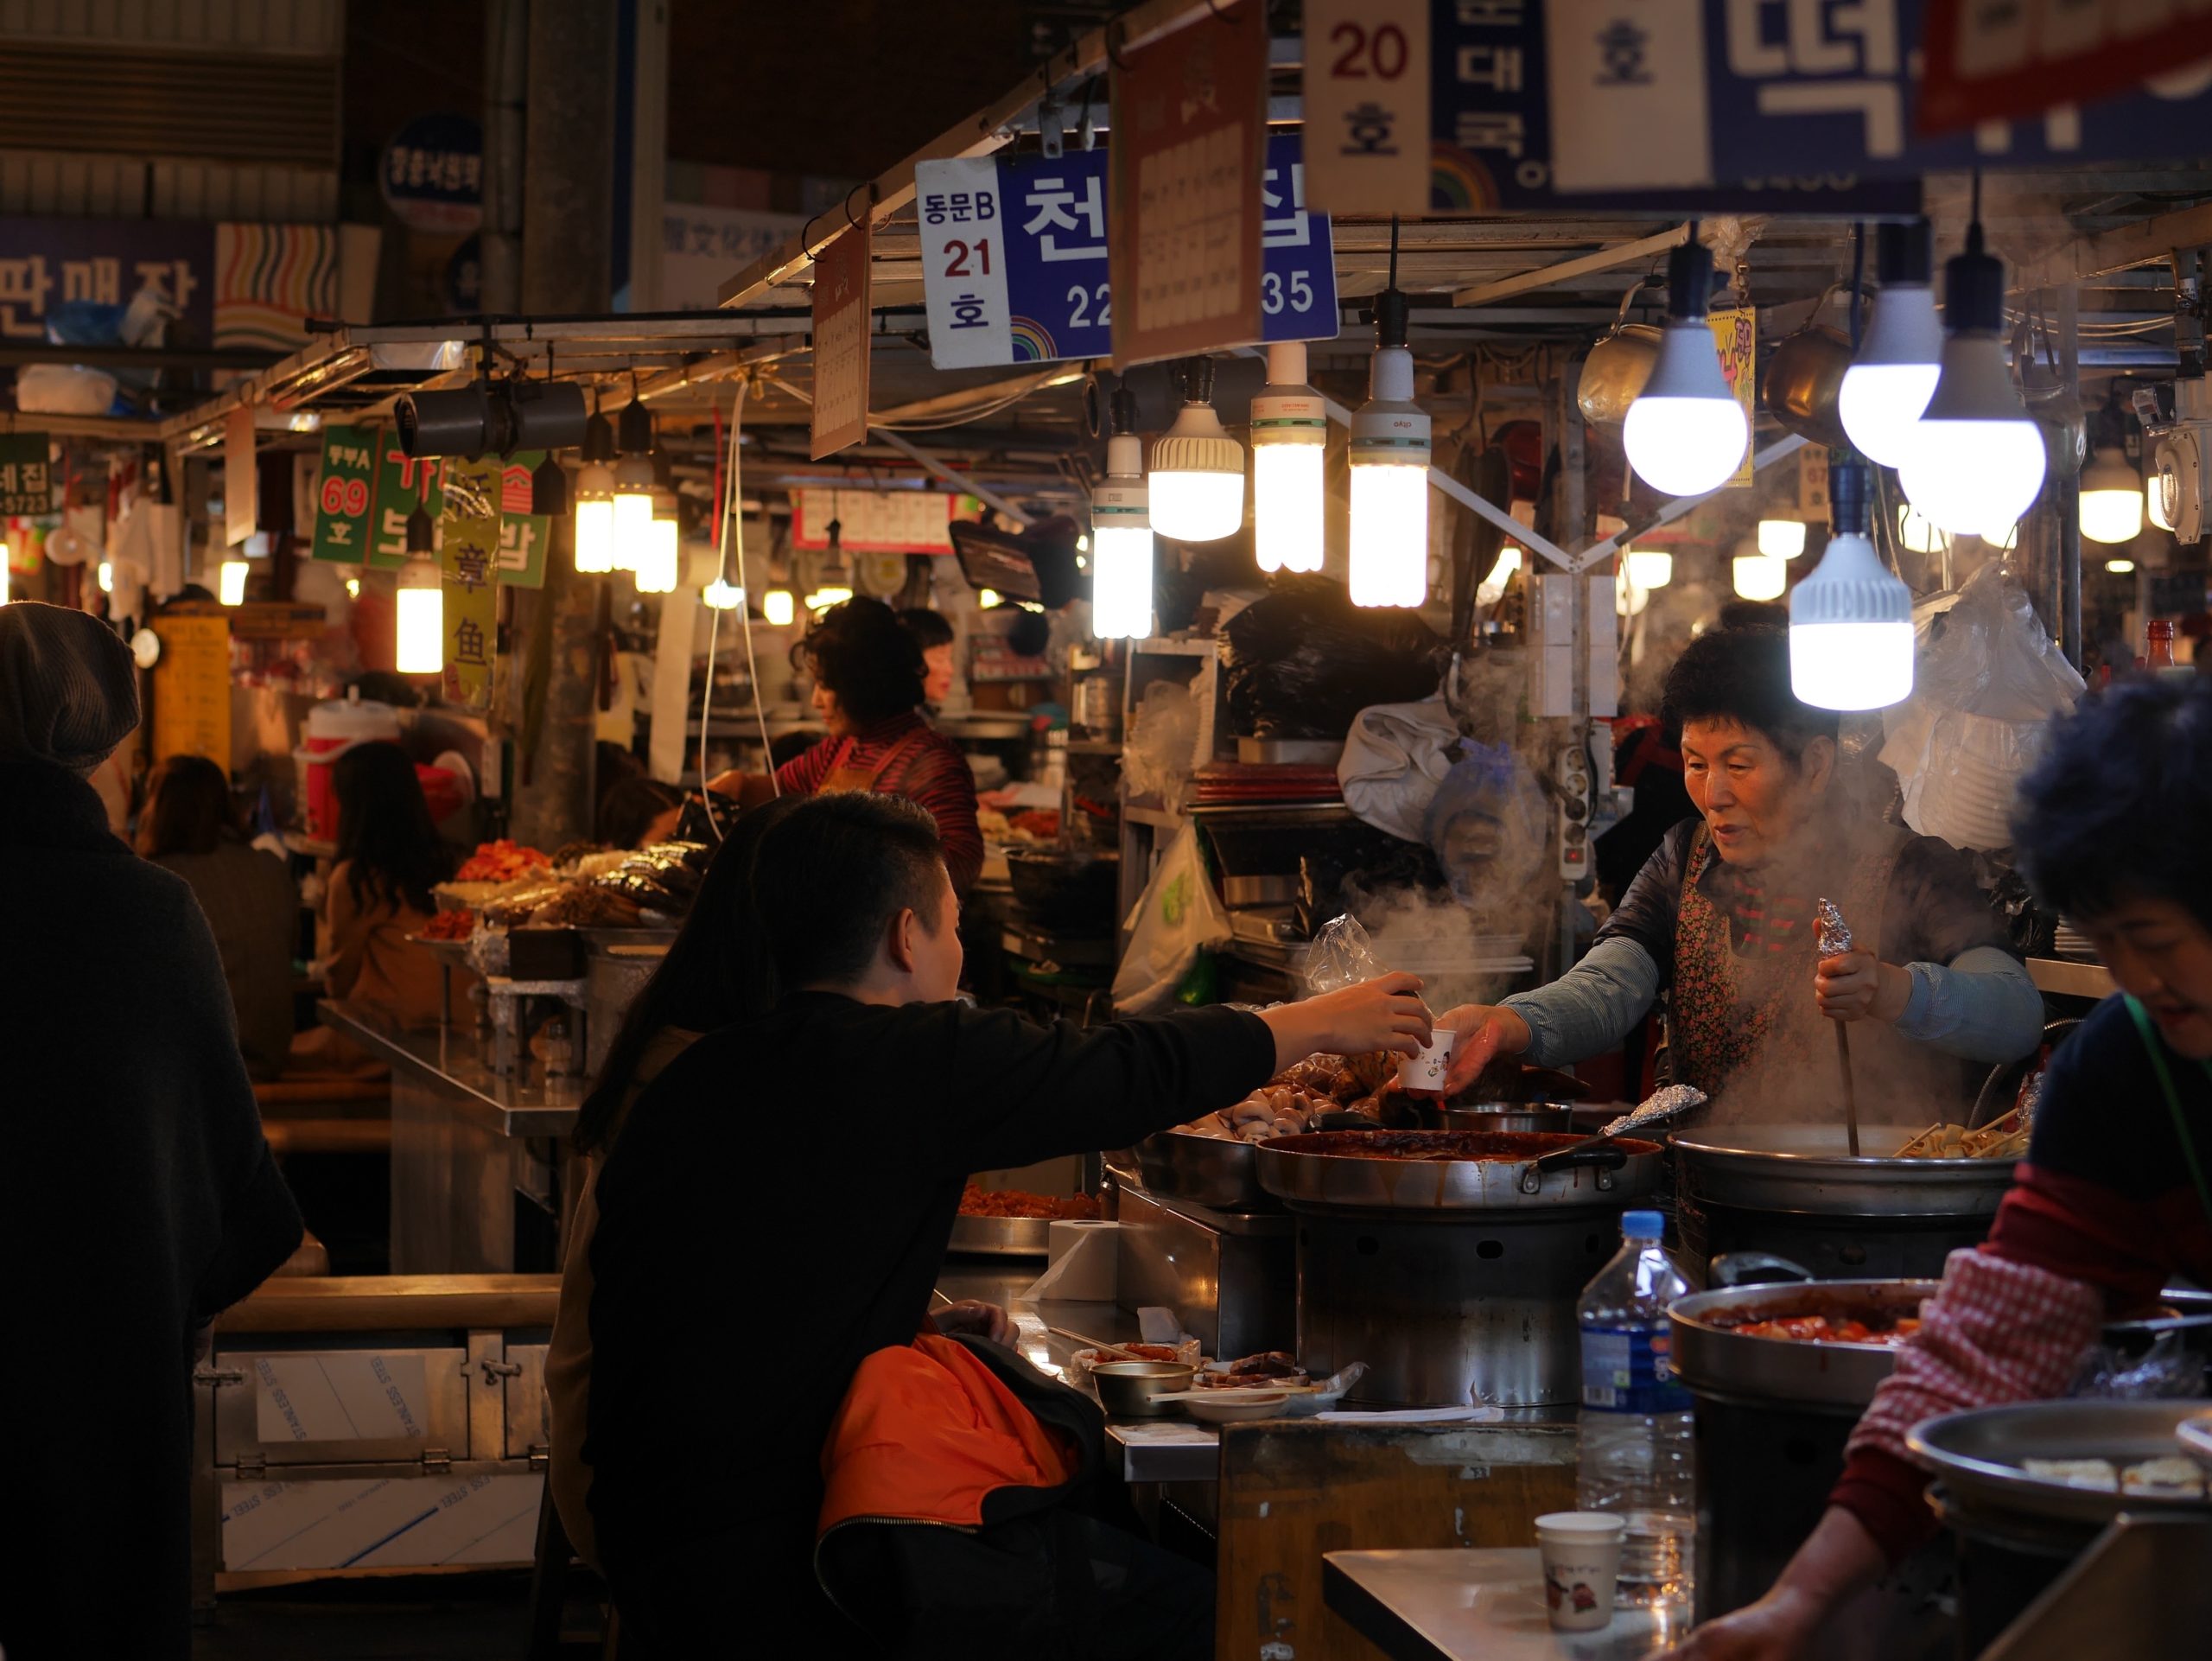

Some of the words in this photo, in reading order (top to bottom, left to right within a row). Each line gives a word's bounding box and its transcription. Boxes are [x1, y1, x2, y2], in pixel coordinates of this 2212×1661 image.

[1330, 22, 1409, 80] 20
[1595, 18, 1653, 86] 호
[1339, 102, 1398, 156] 호
[925, 191, 995, 226] 동문B
[943, 239, 991, 278] 21
[950, 294, 989, 330] 호
[321, 475, 369, 517] 69
[327, 520, 353, 545] 호
